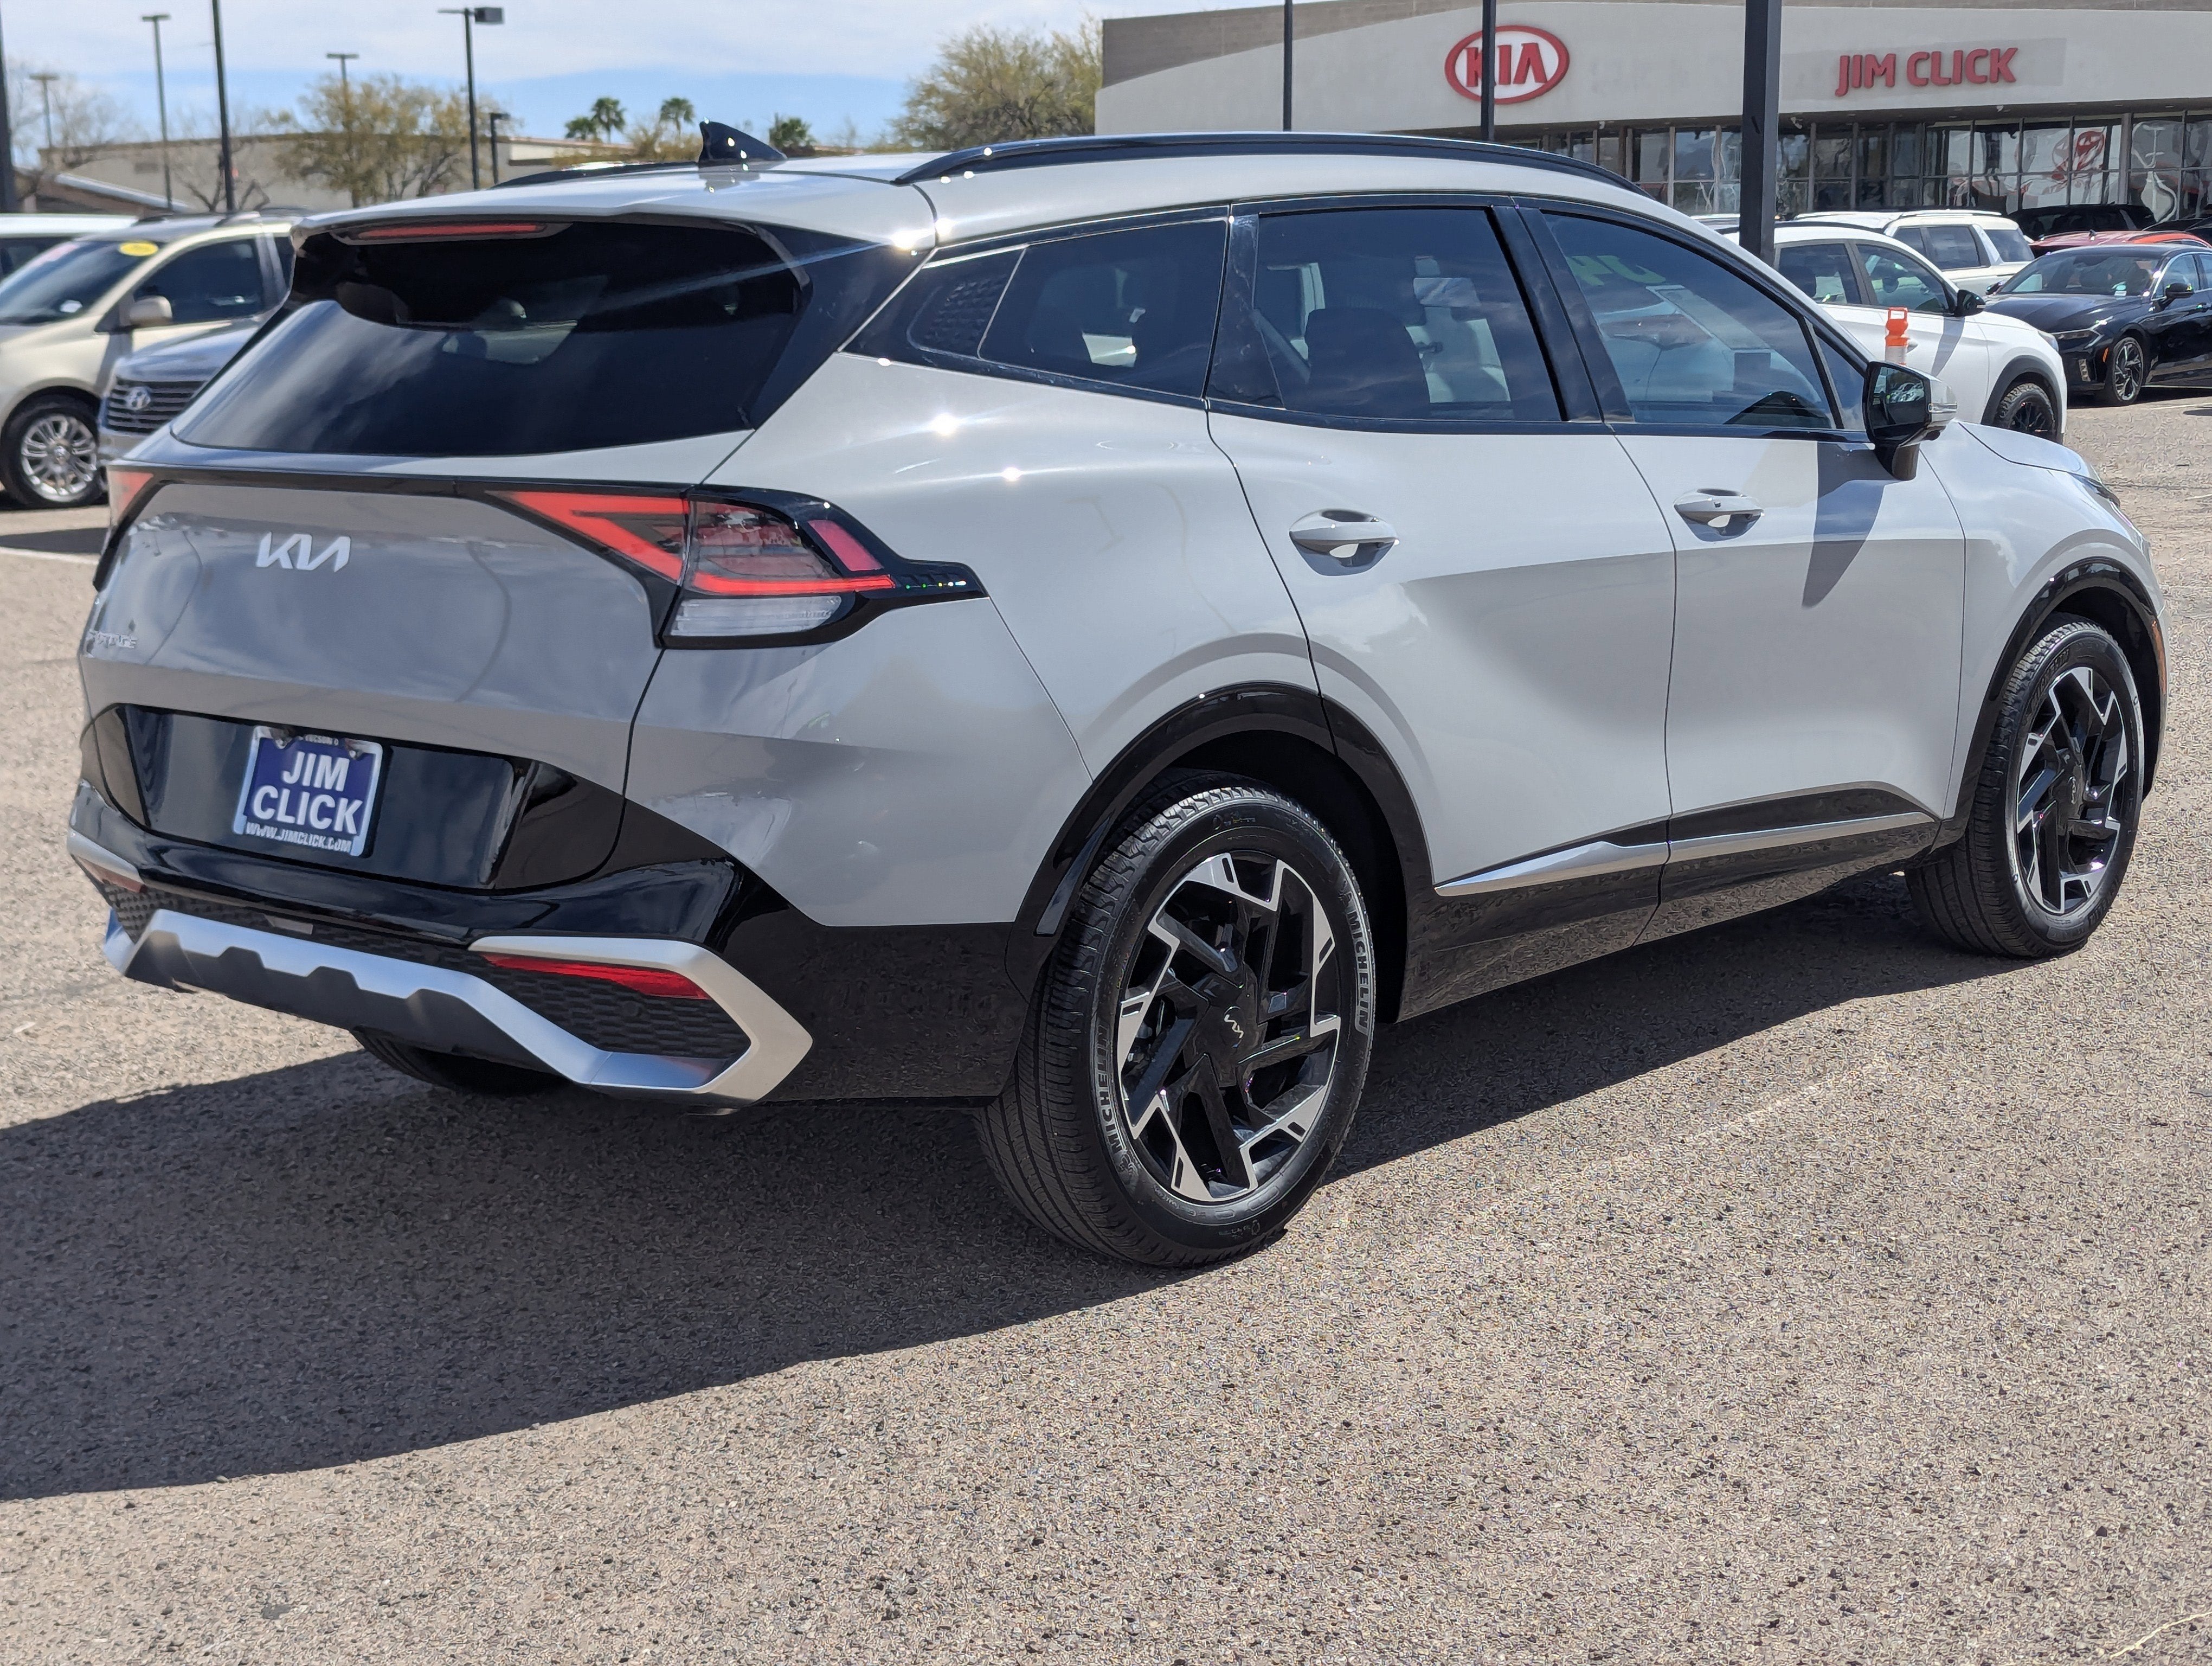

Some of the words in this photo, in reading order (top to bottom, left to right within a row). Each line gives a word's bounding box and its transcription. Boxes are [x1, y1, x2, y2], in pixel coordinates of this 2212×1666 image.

[1464, 42, 1548, 87] KIA
[1835, 53, 1896, 97] JIM
[1906, 47, 2018, 87] CLICK
[256, 531, 351, 573] KIA
[281, 751, 350, 792] JIM
[253, 785, 363, 835] CLICK
[246, 821, 352, 853] WWW.JIMCLICK.COM
[1346, 911, 1369, 1029] MICHELIN
[1096, 1024, 1123, 1153] MICHELIN
